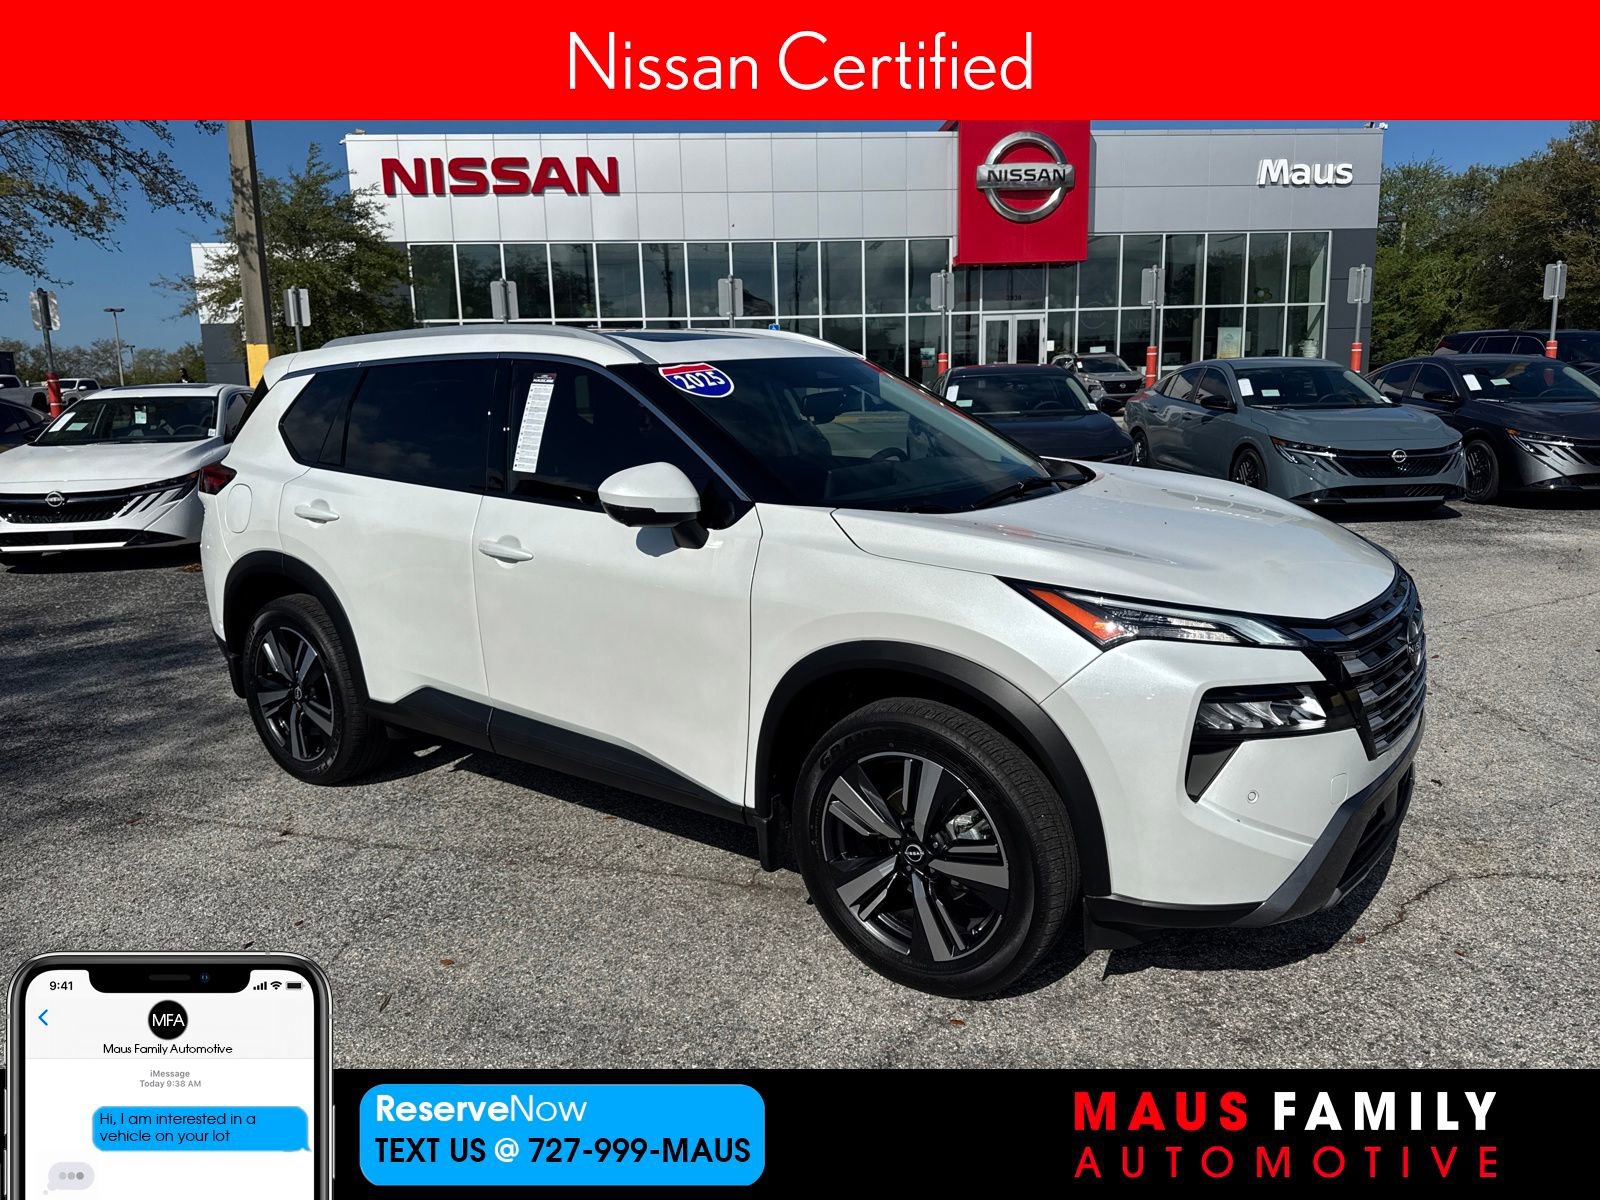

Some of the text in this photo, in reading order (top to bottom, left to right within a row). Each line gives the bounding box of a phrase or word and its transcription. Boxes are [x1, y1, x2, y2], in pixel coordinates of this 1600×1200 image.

[381, 156, 620, 197] NISSAN
[987, 168, 1066, 182] NISSAN
[1257, 158, 1354, 188] Maus
[673, 371, 726, 390] 2025
